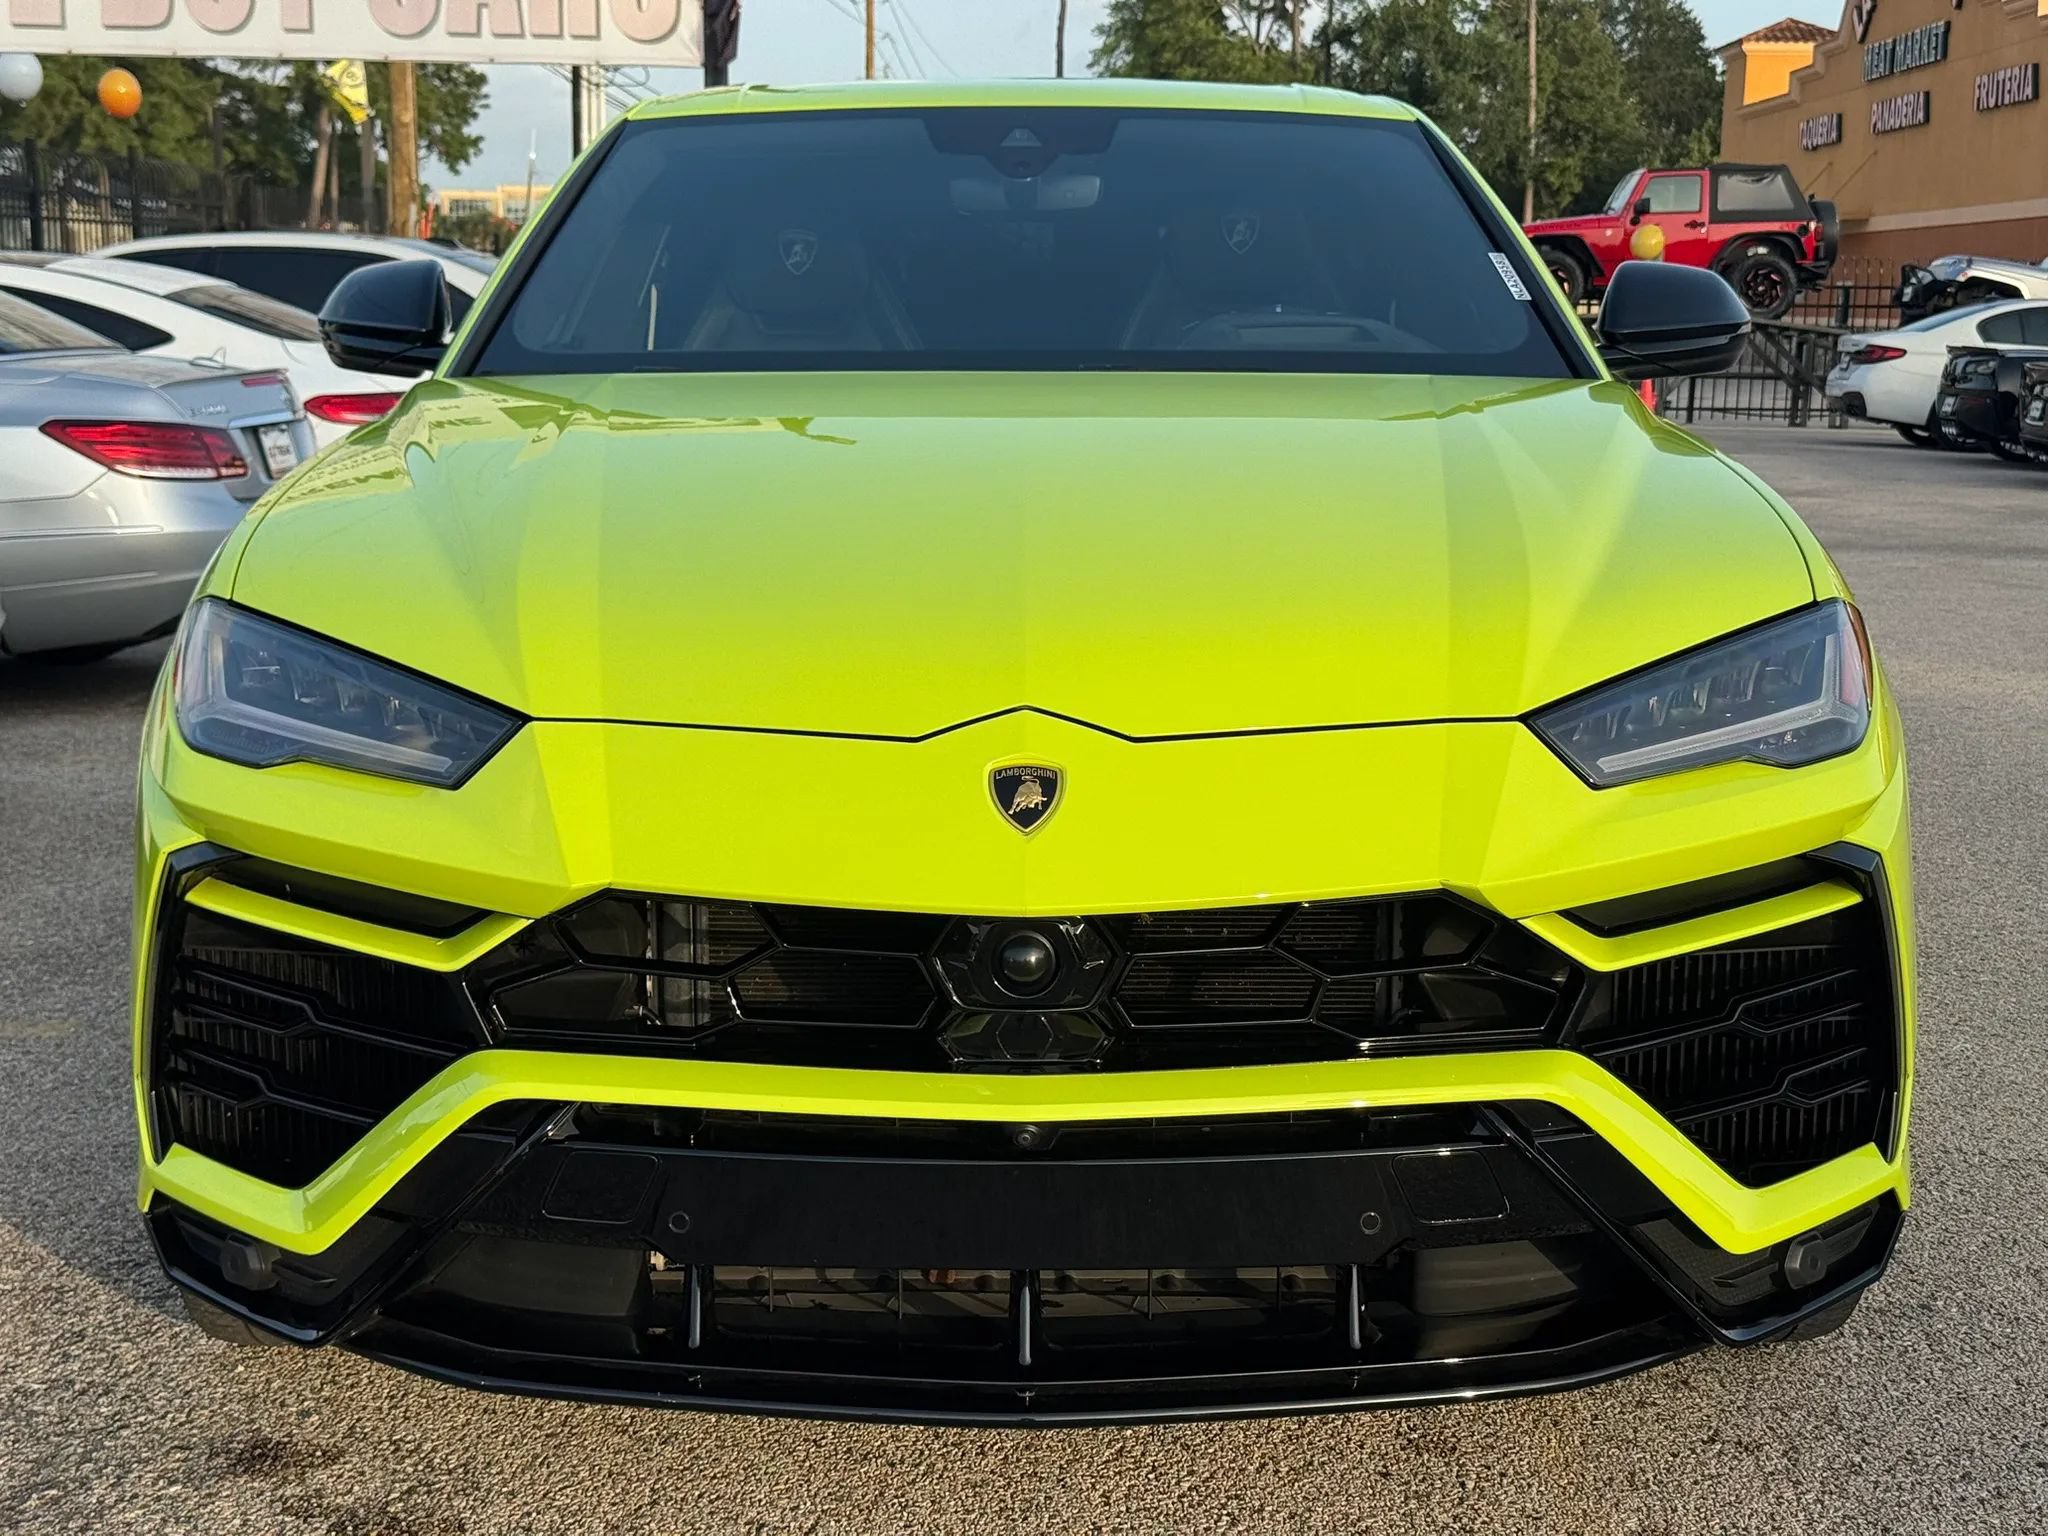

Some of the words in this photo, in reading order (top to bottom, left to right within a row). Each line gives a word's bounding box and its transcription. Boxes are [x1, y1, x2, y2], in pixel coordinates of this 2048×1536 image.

[1863, 38, 1895, 81] MEAT
[1894, 20, 1947, 74] MARKET
[1973, 63, 2034, 112] FRUTERIA
[1870, 90, 1925, 135] PANADERIA
[995, 767, 1056, 780] LAMBORGHINI
